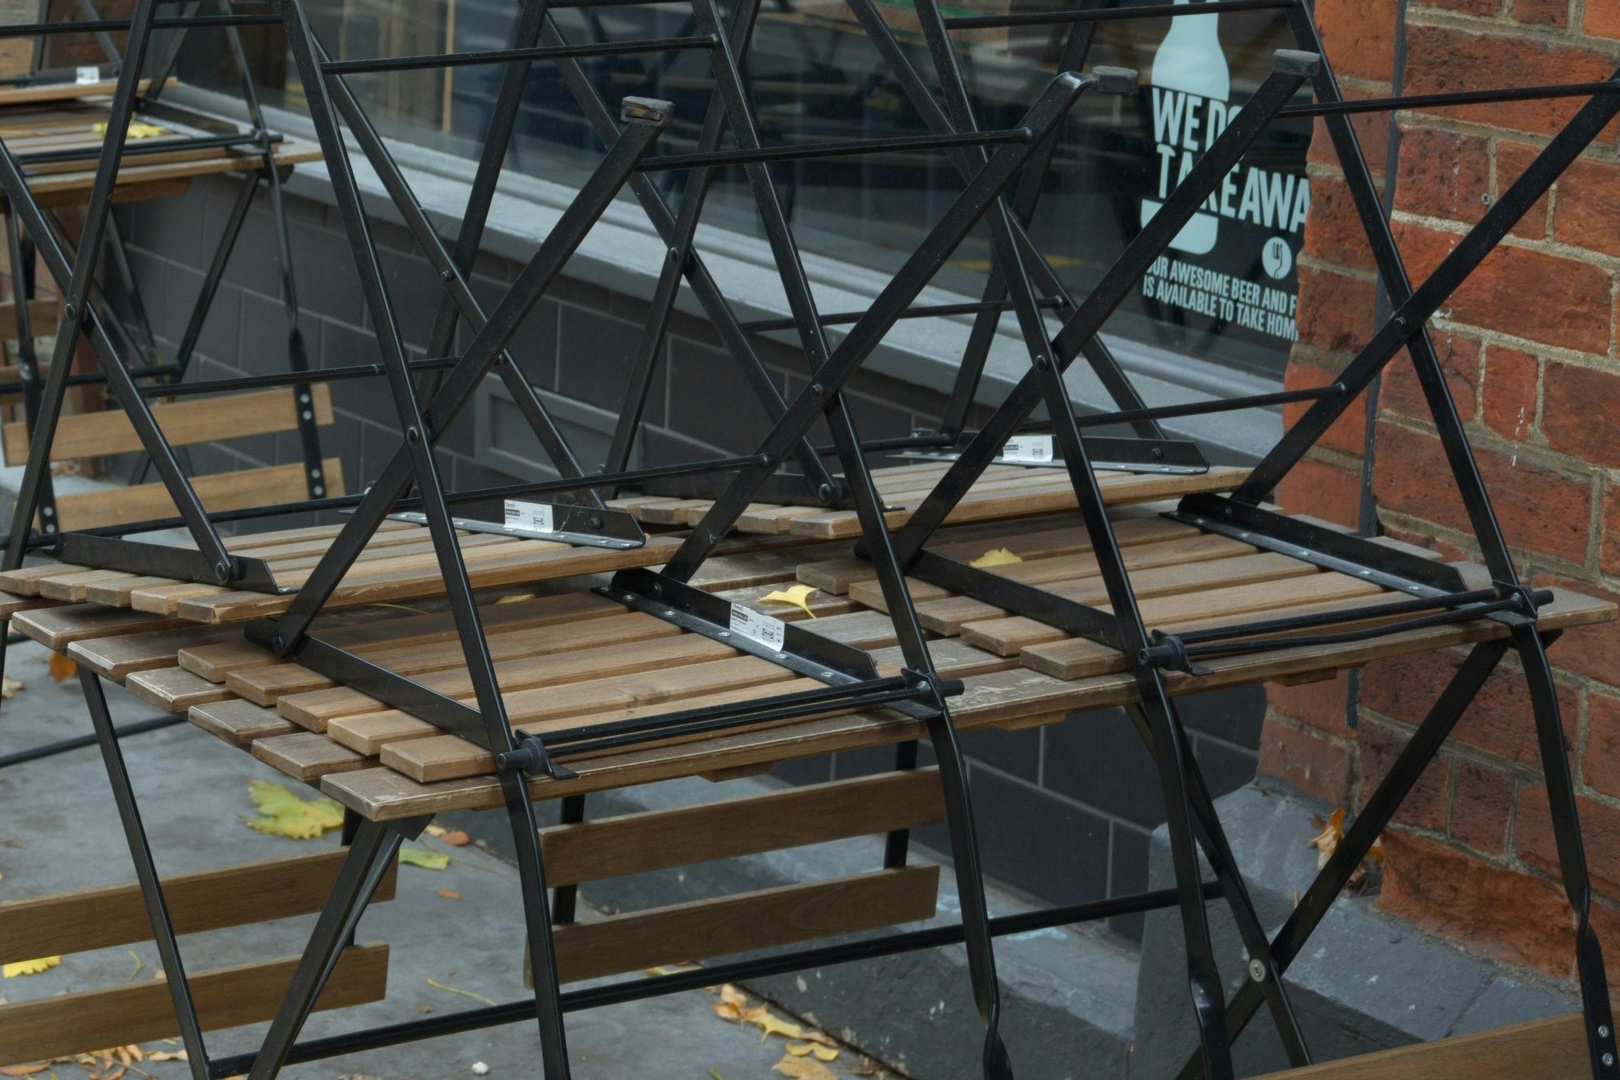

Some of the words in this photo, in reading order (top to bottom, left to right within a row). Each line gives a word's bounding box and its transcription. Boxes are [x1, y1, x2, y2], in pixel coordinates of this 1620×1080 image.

[1152, 87, 1202, 152] WE
[1142, 274, 1155, 297] IS
[1156, 279, 1217, 318] AVAILABLE
[1219, 297, 1234, 322] TO
[1236, 302, 1265, 332] TAKE
[1169, 260, 1230, 296] AWESOME
[1231, 277, 1261, 306] BEER
[1261, 287, 1288, 313] AND
